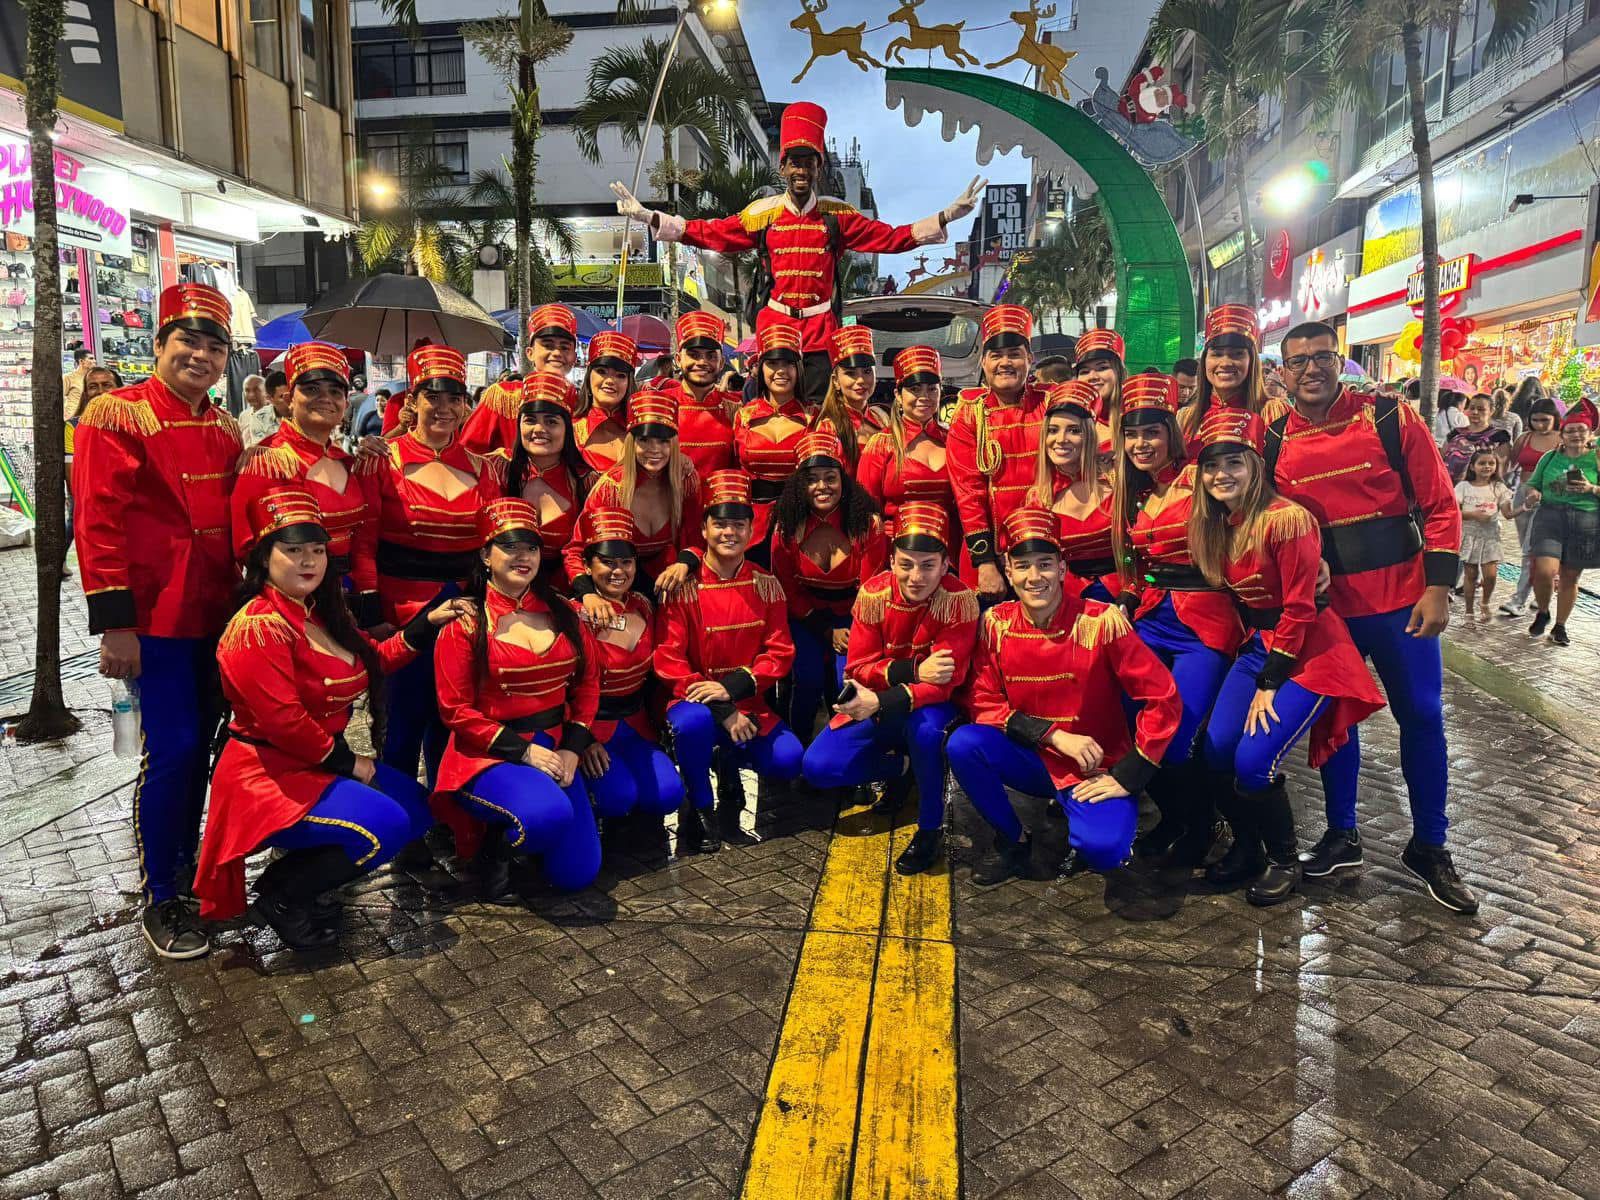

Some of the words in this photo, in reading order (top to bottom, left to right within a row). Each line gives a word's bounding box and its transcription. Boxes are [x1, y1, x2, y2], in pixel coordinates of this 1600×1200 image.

[0, 144, 84, 181] PLAET
[988, 187, 1017, 203] DIS
[0, 180, 127, 237] HOLYWOOD
[992, 203, 1021, 218] PO
[998, 219, 1022, 233] NI
[1002, 233, 1025, 248] BLE
[1406, 259, 1463, 302] BUCAANGA
